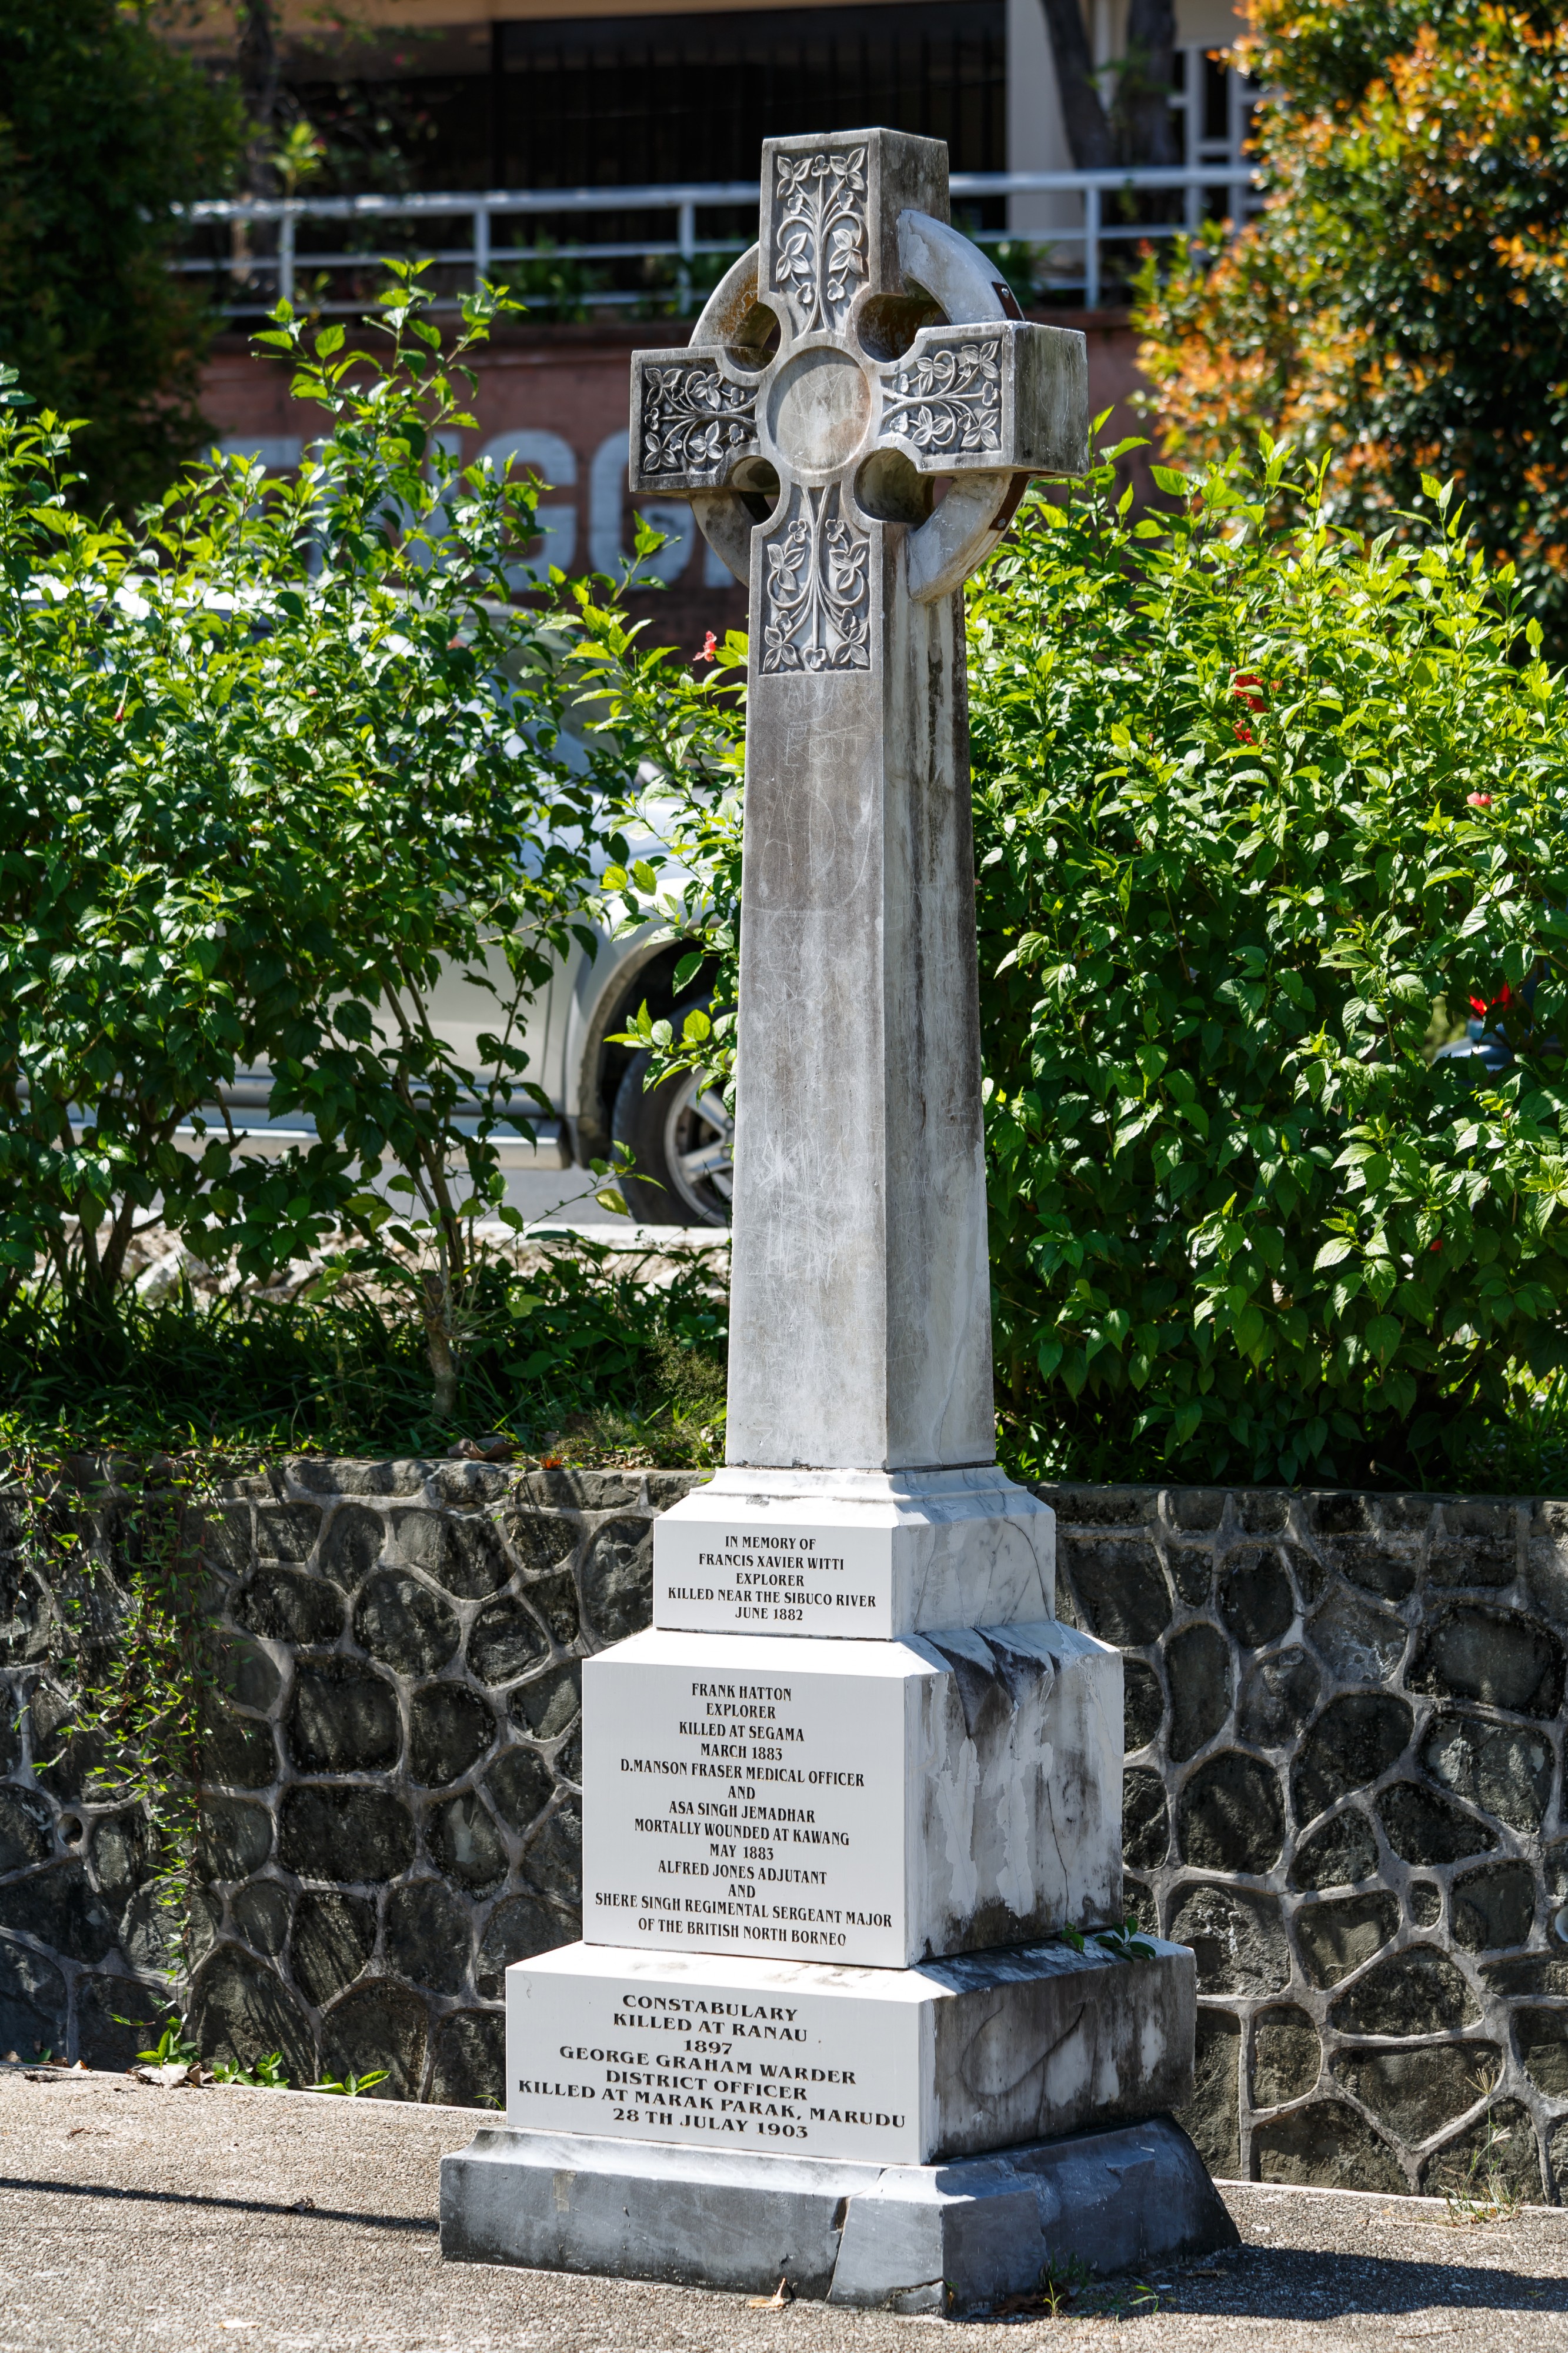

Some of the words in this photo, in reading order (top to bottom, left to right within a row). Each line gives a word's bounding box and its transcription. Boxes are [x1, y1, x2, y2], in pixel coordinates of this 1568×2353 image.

[725, 1535, 738, 1548] IN
[742, 1536, 796, 1550] MEMORY
[799, 1538, 816, 1551] OF
[699, 1553, 754, 1567] FRANCIS
[757, 1555, 804, 1569] XAVIER
[807, 1557, 844, 1571] WITTI
[736, 1572, 805, 1587] EXPLORER
[668, 1587, 714, 1600] KILLED
[718, 1589, 752, 1602] NEAR
[755, 1591, 780, 1604] THE
[784, 1592, 832, 1605] SIBUCO
[836, 1594, 876, 1607] RIVER
[735, 1607, 768, 1619] JUNE
[773, 1608, 803, 1621] 1882
[692, 1682, 736, 1698] FRANK
[739, 1685, 792, 1701] HATTON
[706, 1702, 776, 1719] EXPLORER
[679, 1721, 726, 1737] KILLED
[729, 1724, 746, 1738] AT
[749, 1725, 805, 1742] SEGAMA
[700, 1743, 747, 1759] MARCH
[752, 1747, 783, 1761] 1883
[620, 1758, 688, 1775] D.MANSON
[692, 1762, 743, 1779] FRASER
[746, 1766, 805, 1783] MEDICAL
[808, 1770, 865, 1787] OFFICER
[728, 1785, 756, 1799] AND
[669, 1801, 695, 1815] ASA
[698, 1802, 738, 1818] SINGH
[741, 1805, 815, 1823] JEMADHAR
[635, 1818, 701, 1835] MORTALLY
[704, 1822, 770, 1840] WOUNDED
[773, 1828, 790, 1841] AT
[793, 1829, 849, 1846] KAWANG
[710, 1843, 736, 1858] MAY
[743, 1846, 774, 1861] 1883
[658, 1859, 709, 1876] ALFRED
[712, 1864, 755, 1879] JONES
[758, 1867, 827, 1885] ADJUTANT
[728, 1884, 756, 1898] AND
[595, 1892, 637, 1907] SHERE
[641, 1895, 680, 1911] SINGH
[685, 1899, 769, 1918] REGIMENTAL
[772, 1905, 842, 1924] SERGEANT
[846, 1911, 892, 1928] MAJOR
[638, 1917, 655, 1931] OF
[658, 1919, 683, 1934] THE
[688, 1921, 739, 1938] BRITISH
[743, 1926, 787, 1942] NORTH
[792, 1929, 846, 1947] BORNEO
[622, 1995, 798, 2022] CONSTABULARY
[613, 2013, 692, 2031] KILLED
[698, 2020, 725, 2034] AT
[732, 2023, 807, 2042] RANAU
[685, 2039, 732, 2055] 1897
[559, 2046, 649, 2065] GEORGE
[656, 2054, 752, 2075] GRAHAM
[759, 2064, 856, 2085] WARDER
[606, 2069, 708, 2091] DISTRICT
[713, 2080, 808, 2101] OFFICER
[519, 2079, 596, 2098] KILLED
[601, 2088, 628, 2102] AT
[635, 2091, 714, 2110] MARAK
[721, 2098, 802, 2121] PARAK,
[810, 2107, 905, 2128] MARUDU
[612, 2108, 640, 2122] 28
[645, 2111, 673, 2125] TH
[679, 2115, 749, 2132] JULAY
[757, 2122, 809, 2138] 1903
